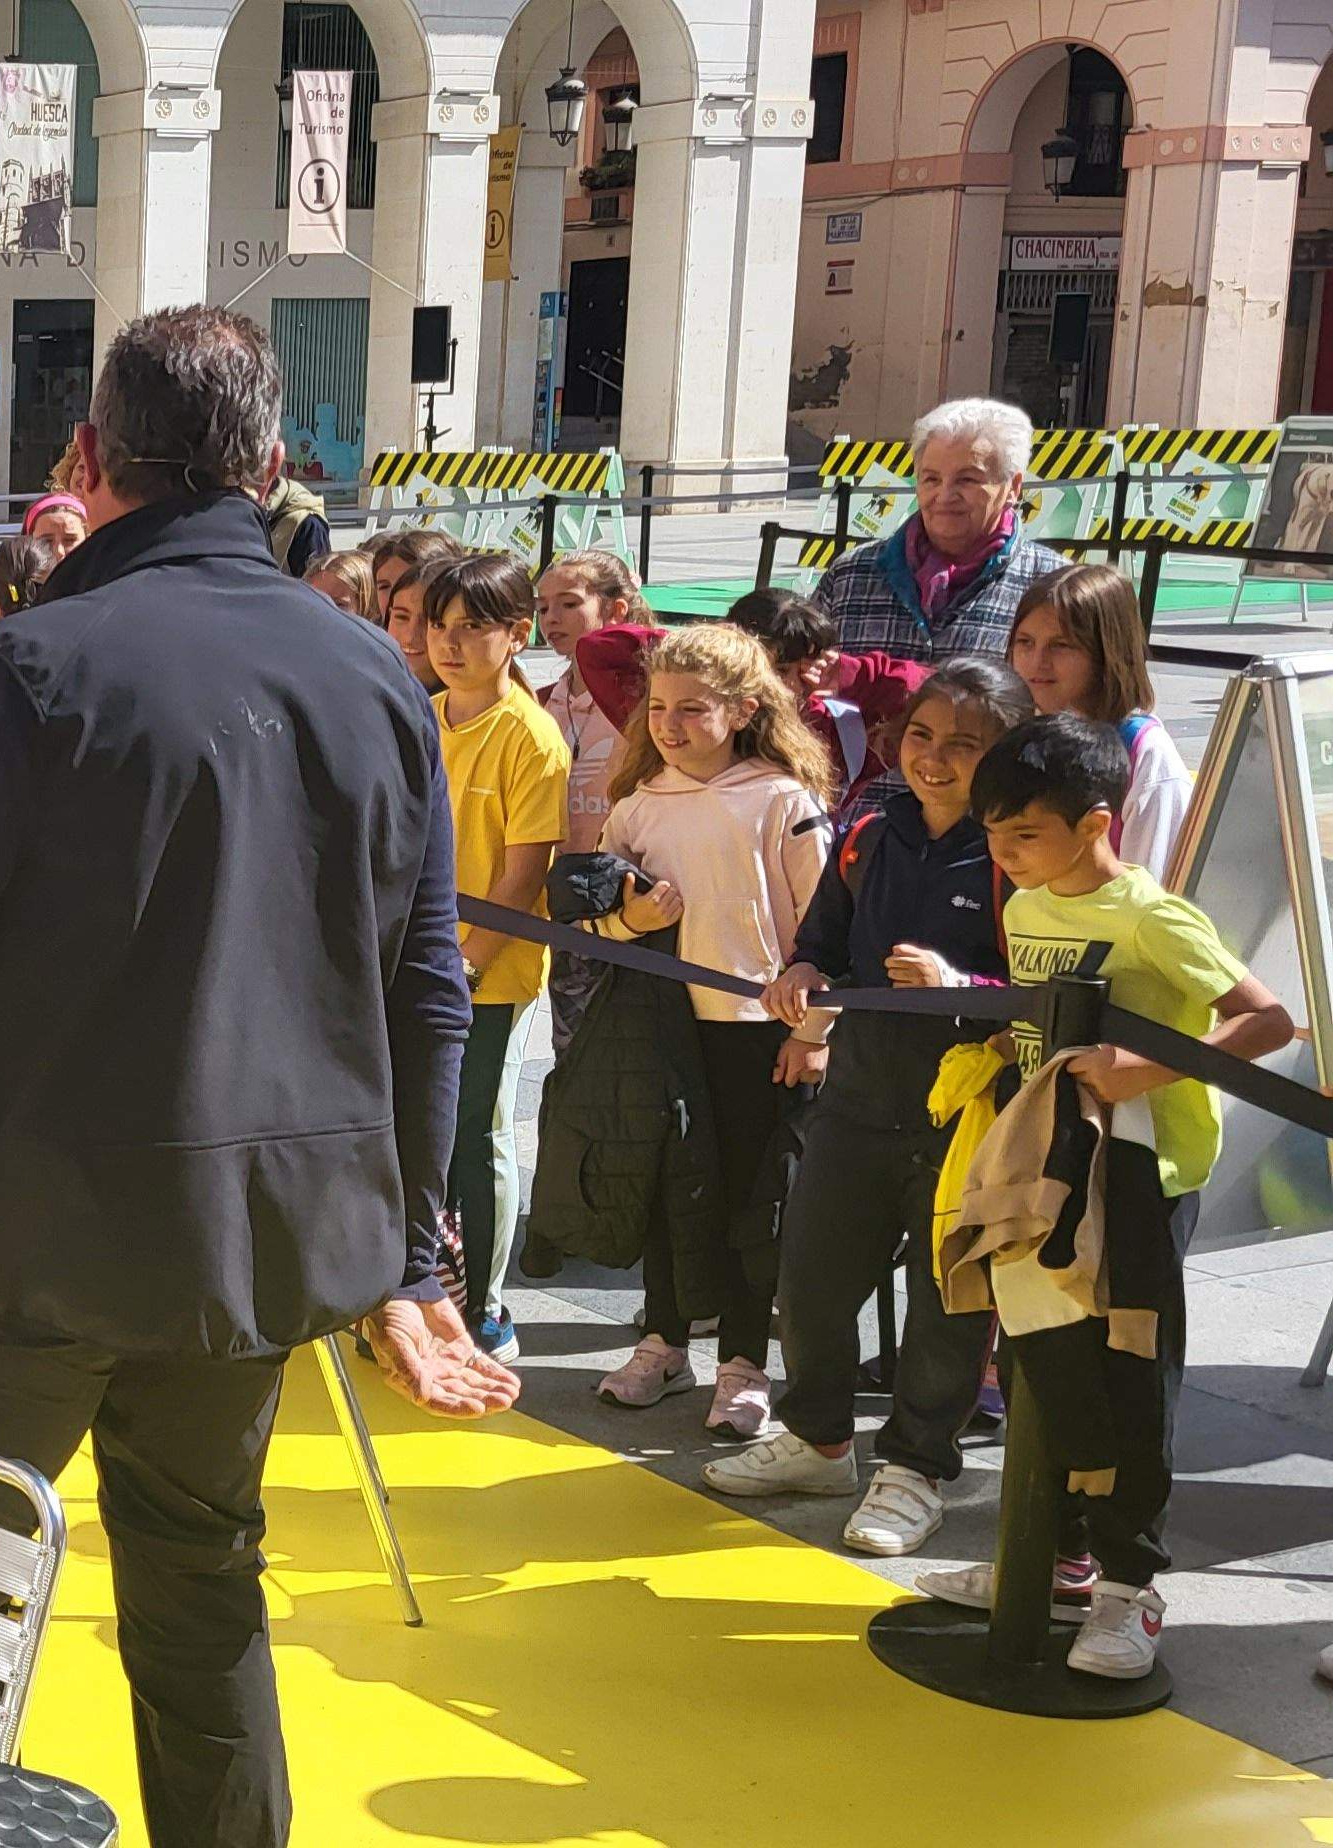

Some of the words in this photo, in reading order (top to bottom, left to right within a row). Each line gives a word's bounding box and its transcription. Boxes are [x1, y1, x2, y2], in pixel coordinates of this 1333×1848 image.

[306, 89, 345, 102] Oficina
[30, 102, 68, 122] HUESCA
[330, 105, 344, 118] de
[298, 122, 344, 135] Turismo
[492, 149, 514, 159] ficina
[209, 240, 309, 267] ISMO
[1015, 239, 1096, 259] CHACINERIA
[569, 790, 612, 817] das
